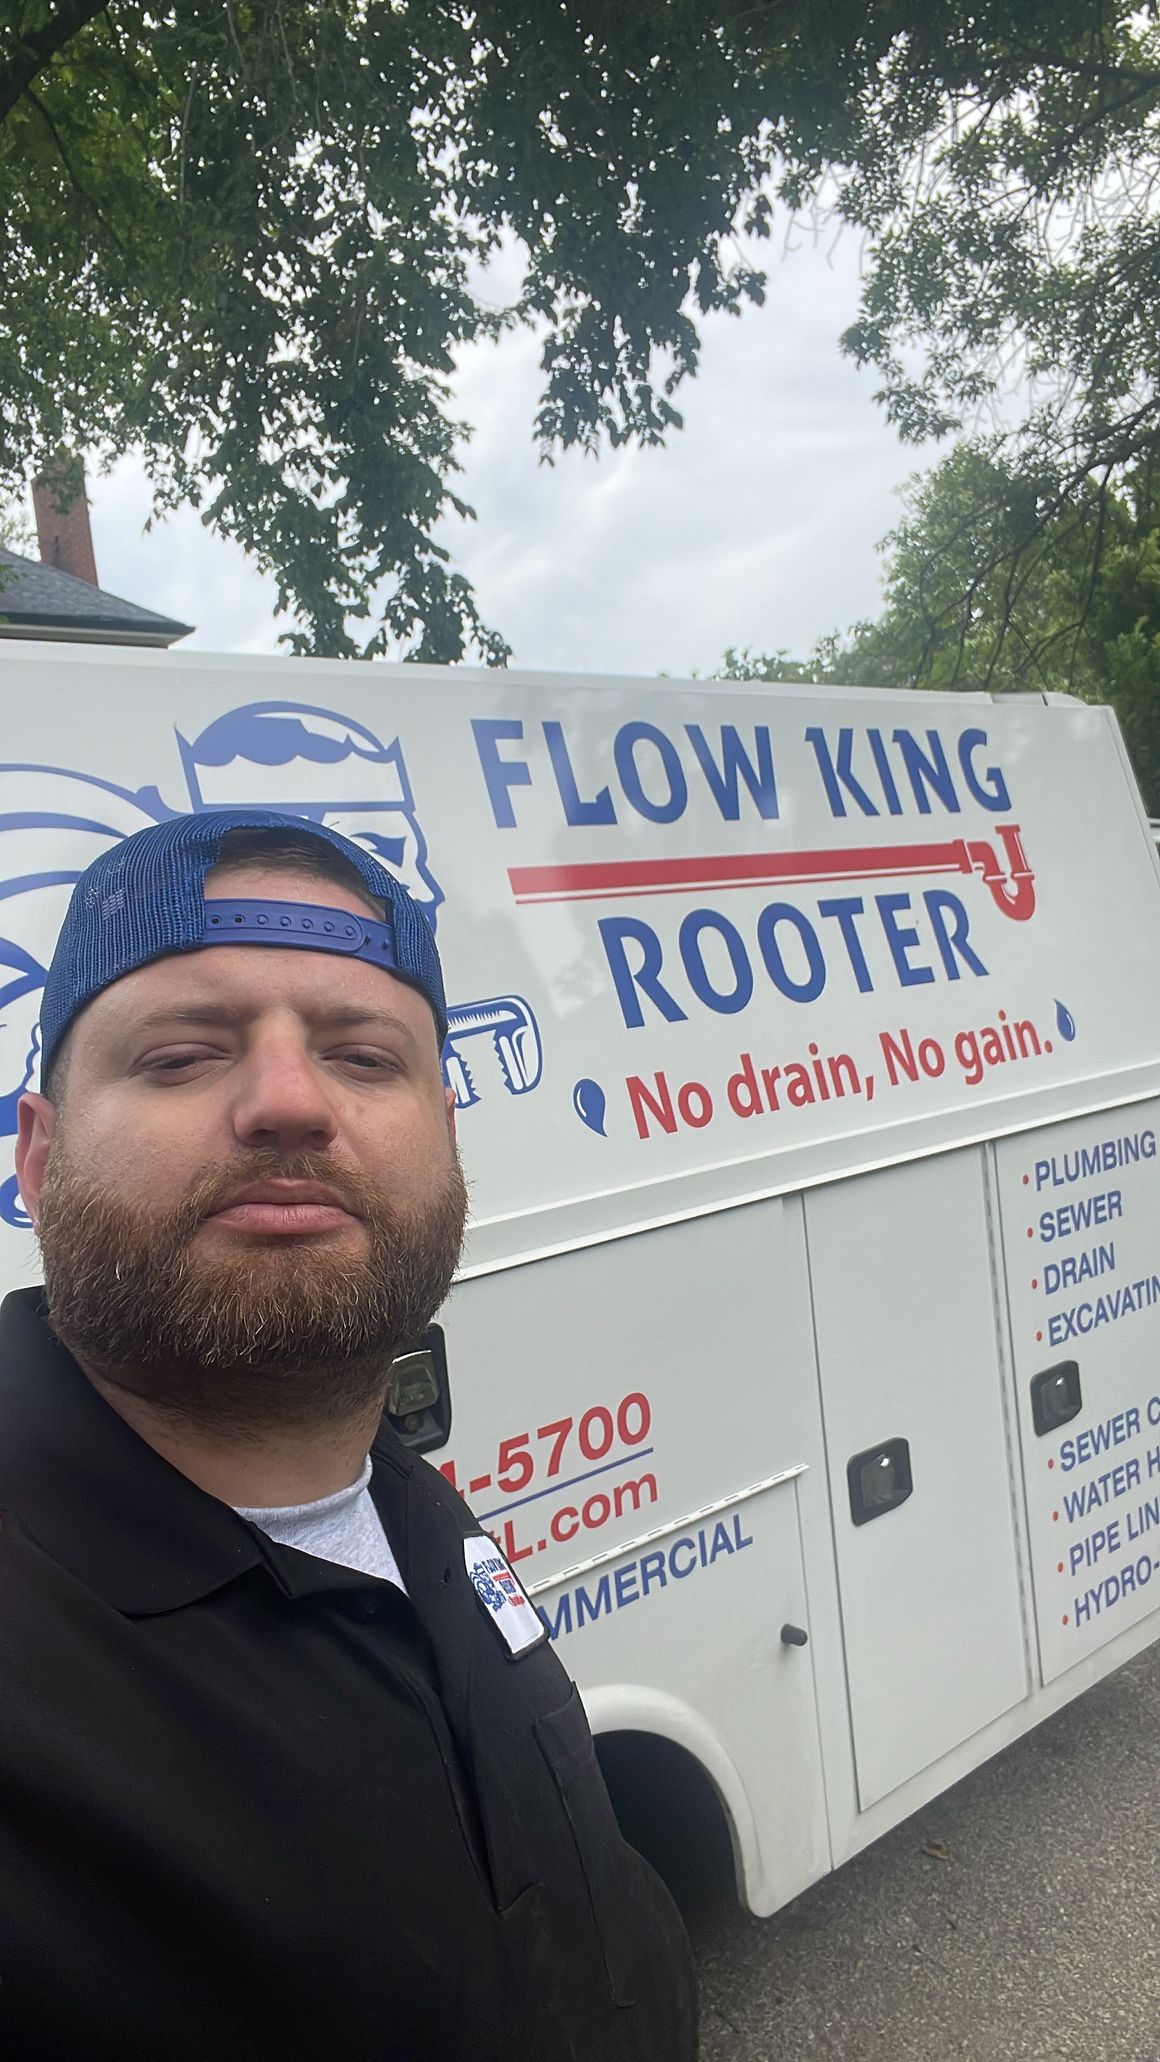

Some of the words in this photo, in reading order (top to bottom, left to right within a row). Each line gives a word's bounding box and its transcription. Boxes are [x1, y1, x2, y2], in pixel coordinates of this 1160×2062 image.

[470, 718, 780, 829] FLOW
[804, 726, 1013, 817] KING
[597, 889, 989, 1029] ROOTER
[626, 1073, 713, 1139] No
[728, 1043, 875, 1118] drain,
[879, 1028, 945, 1085] No
[956, 1011, 1053, 1085] gain.
[1034, 1130, 1157, 1191] PLUMBING
[1039, 1190, 1123, 1243] SEWER
[1043, 1242, 1116, 1295] DRAIN
[1060, 1407, 1141, 1472] SEWER
[1063, 1458, 1141, 1523] WATER
[1069, 1520, 1121, 1576] PIPE
